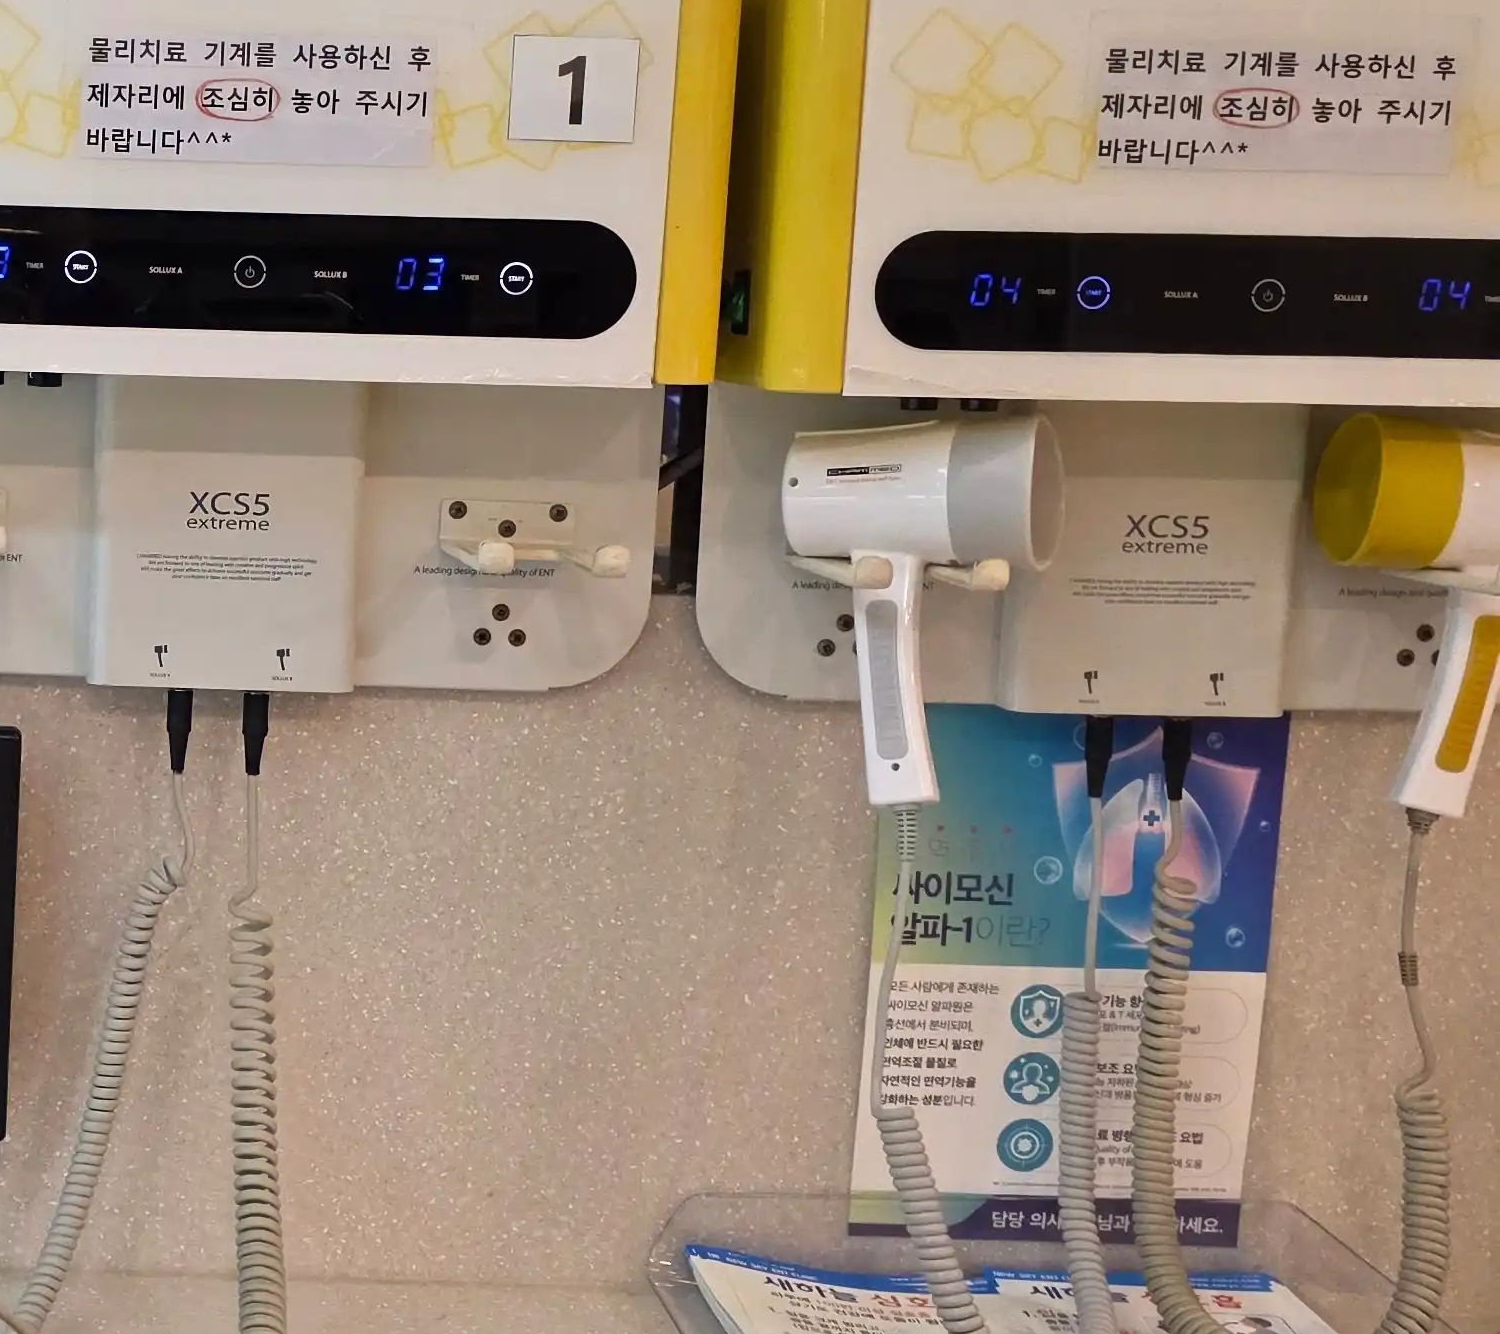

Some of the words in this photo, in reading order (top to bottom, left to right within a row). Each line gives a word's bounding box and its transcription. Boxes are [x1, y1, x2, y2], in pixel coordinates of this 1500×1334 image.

[88, 37, 188, 65] 물리치료
[204, 40, 278, 68] 기계를
[292, 43, 392, 71] 사용하신
[406, 45, 432, 72] 후
[1105, 48, 1207, 76] 물리치료
[1223, 51, 1300, 78] 기계를
[1314, 53, 1417, 80] 사용하신
[1432, 54, 1457, 81] 후
[86, 82, 186, 111] 제자리에
[201, 85, 275, 114] 조심히
[290, 88, 341, 115] 놓아
[354, 90, 430, 117] 주시기
[556, 54, 589, 127] 1
[1100, 93, 1204, 121] 제자리에
[1219, 96, 1295, 123] 조심히
[1311, 98, 1363, 124] 놓아
[1376, 99, 1452, 126] 주시기
[395, 257, 446, 292] 03
[969, 273, 1023, 307] 04
[1418, 278, 1472, 312] 04
[189, 491, 271, 517] XCS5
[186, 517, 271, 531] extreme
[1124, 514, 1211, 540] XCS5
[7, 554, 23, 563] ENT
[1121, 540, 1209, 555] extreme
[422, 565, 453, 576] leading
[529, 568, 538, 577] of
[538, 569, 555, 577] ENT
[800, 580, 832, 591] leading
[1101, 994, 1127, 1009] 기능
[916, 1037, 949, 1051] 반드시
[991, 1210, 1025, 1229] 담당
